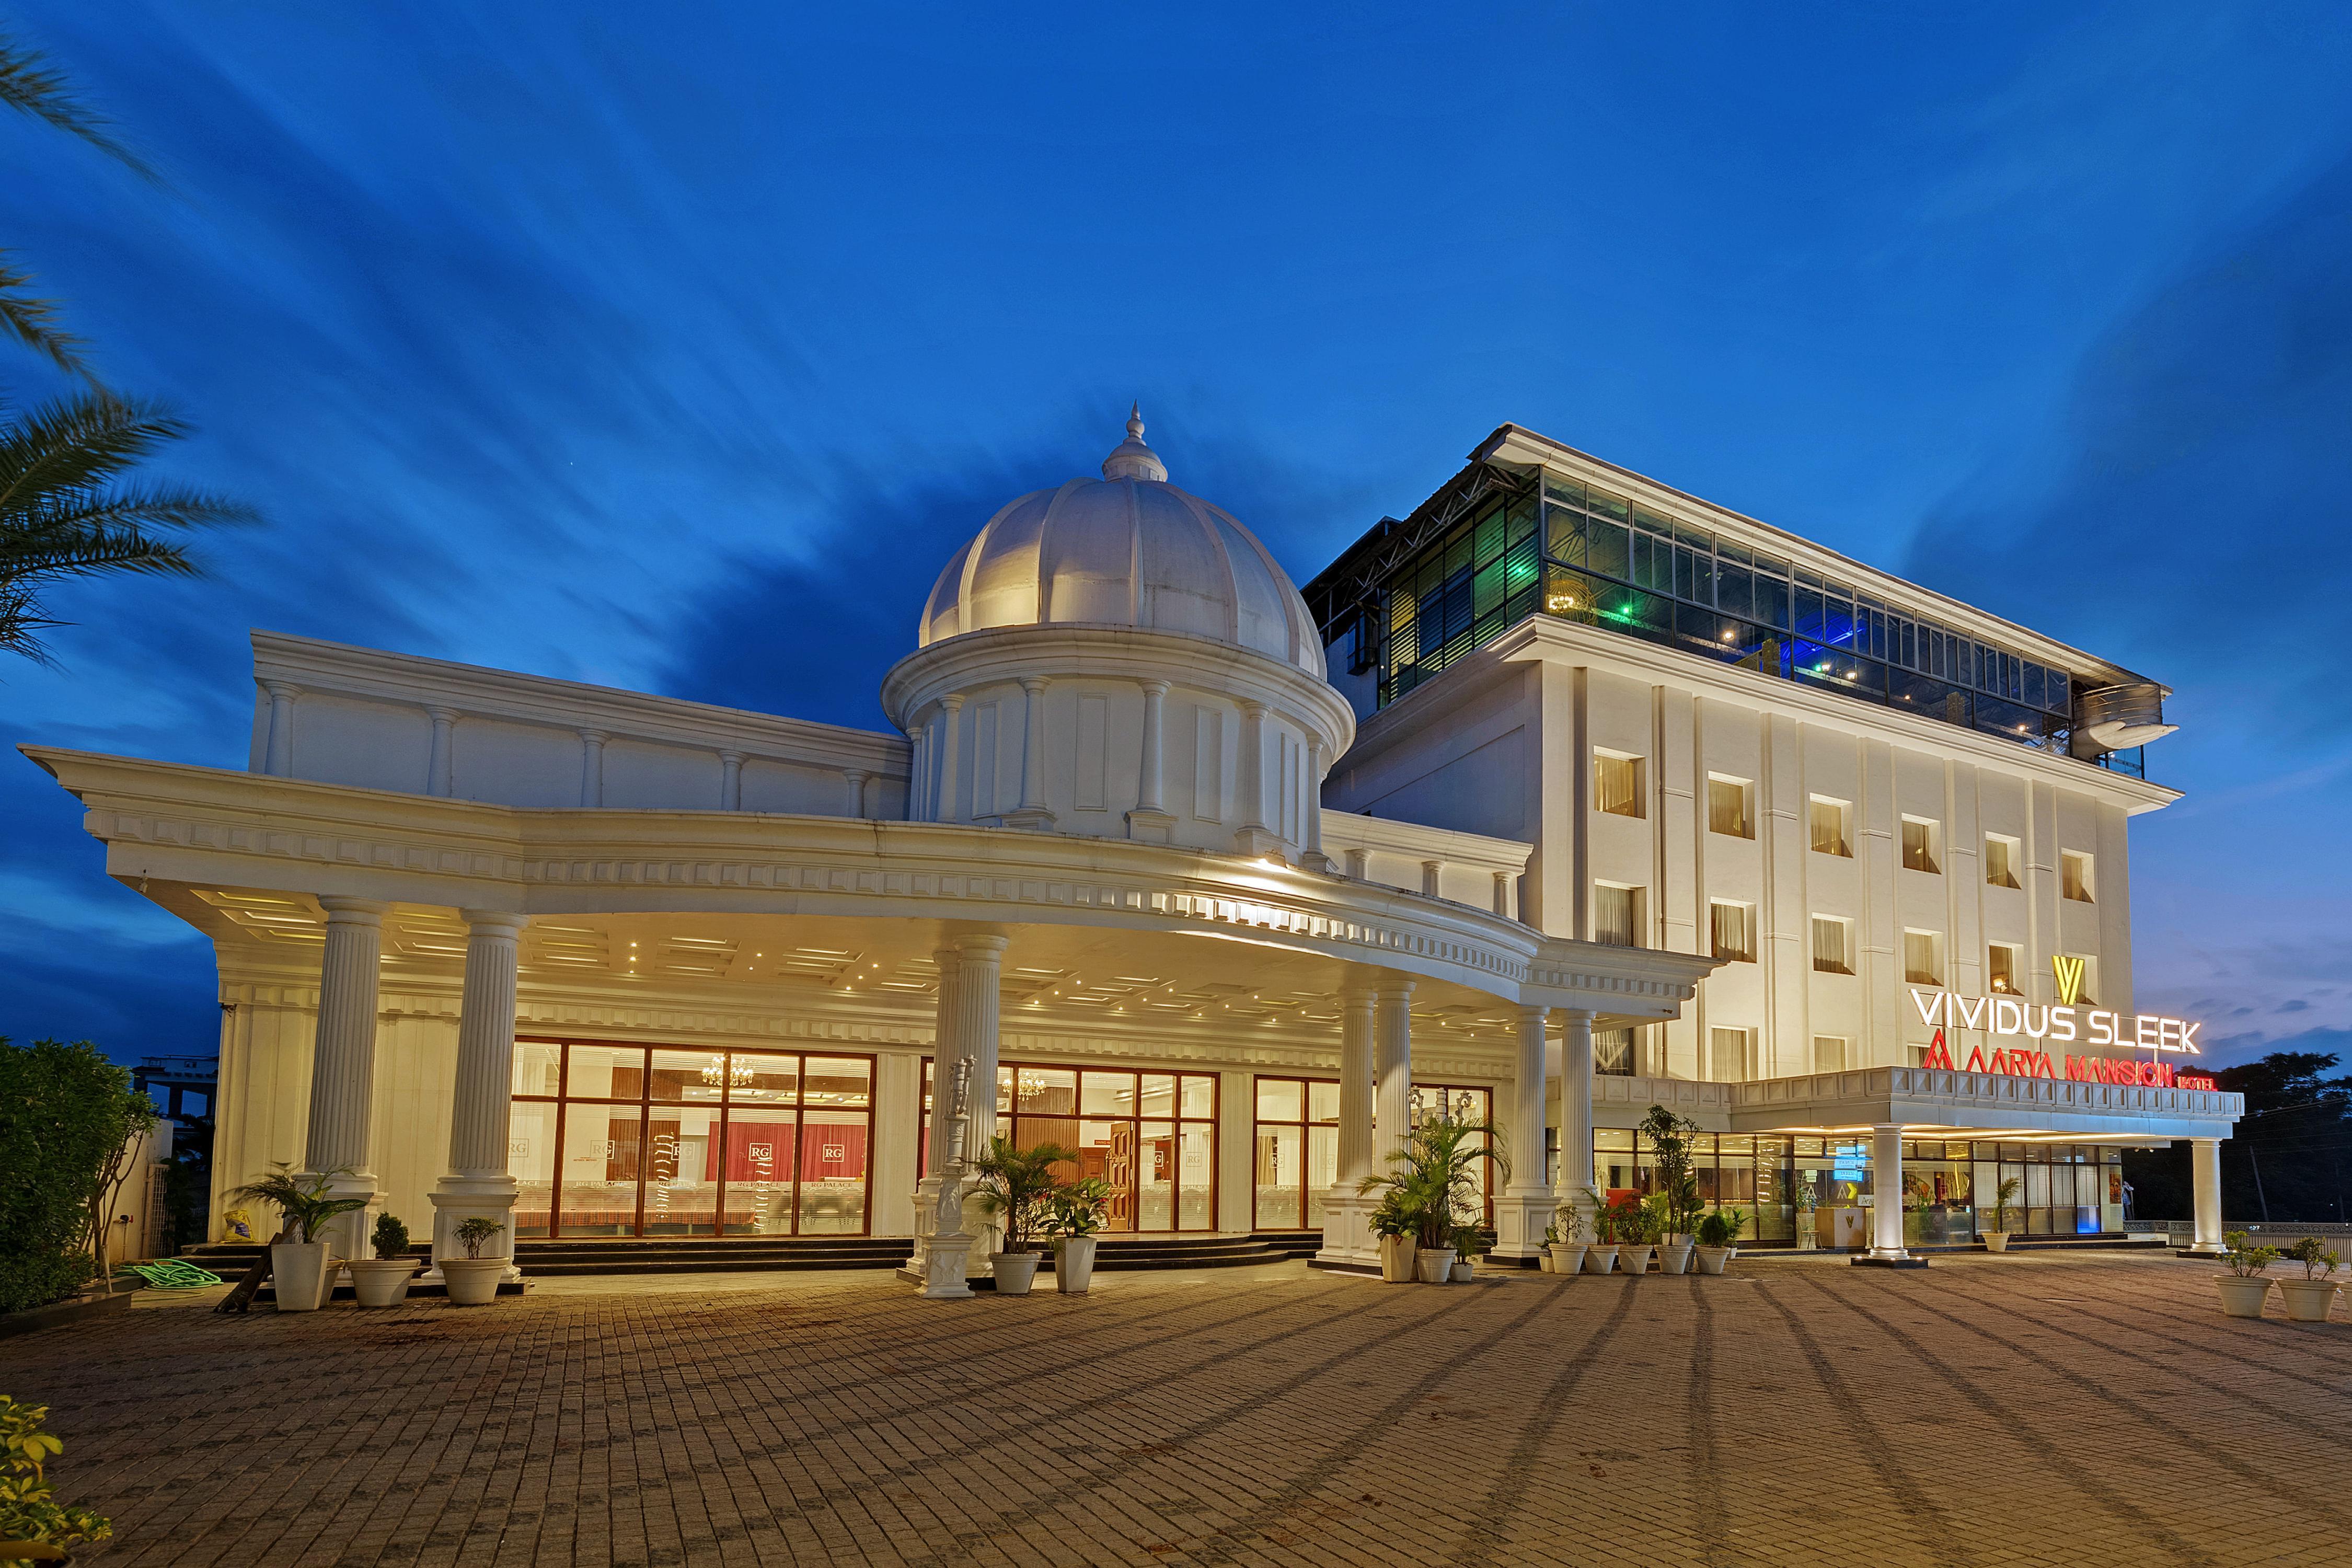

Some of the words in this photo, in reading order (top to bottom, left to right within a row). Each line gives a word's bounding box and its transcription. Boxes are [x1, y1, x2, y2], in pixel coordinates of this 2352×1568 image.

[1909, 988, 2077, 1041] VIVIDUS
[2088, 1010, 2201, 1055] SLEEK
[1966, 1045, 2057, 1079] AARYA
[2066, 1054, 2173, 1088] MANSION
[2177, 1076, 2218, 1091] HOTEL
[593, 1145, 612, 1154] RG
[674, 1147, 692, 1156] RG
[752, 1148, 769, 1157] RG
[825, 1149, 841, 1158] RG
